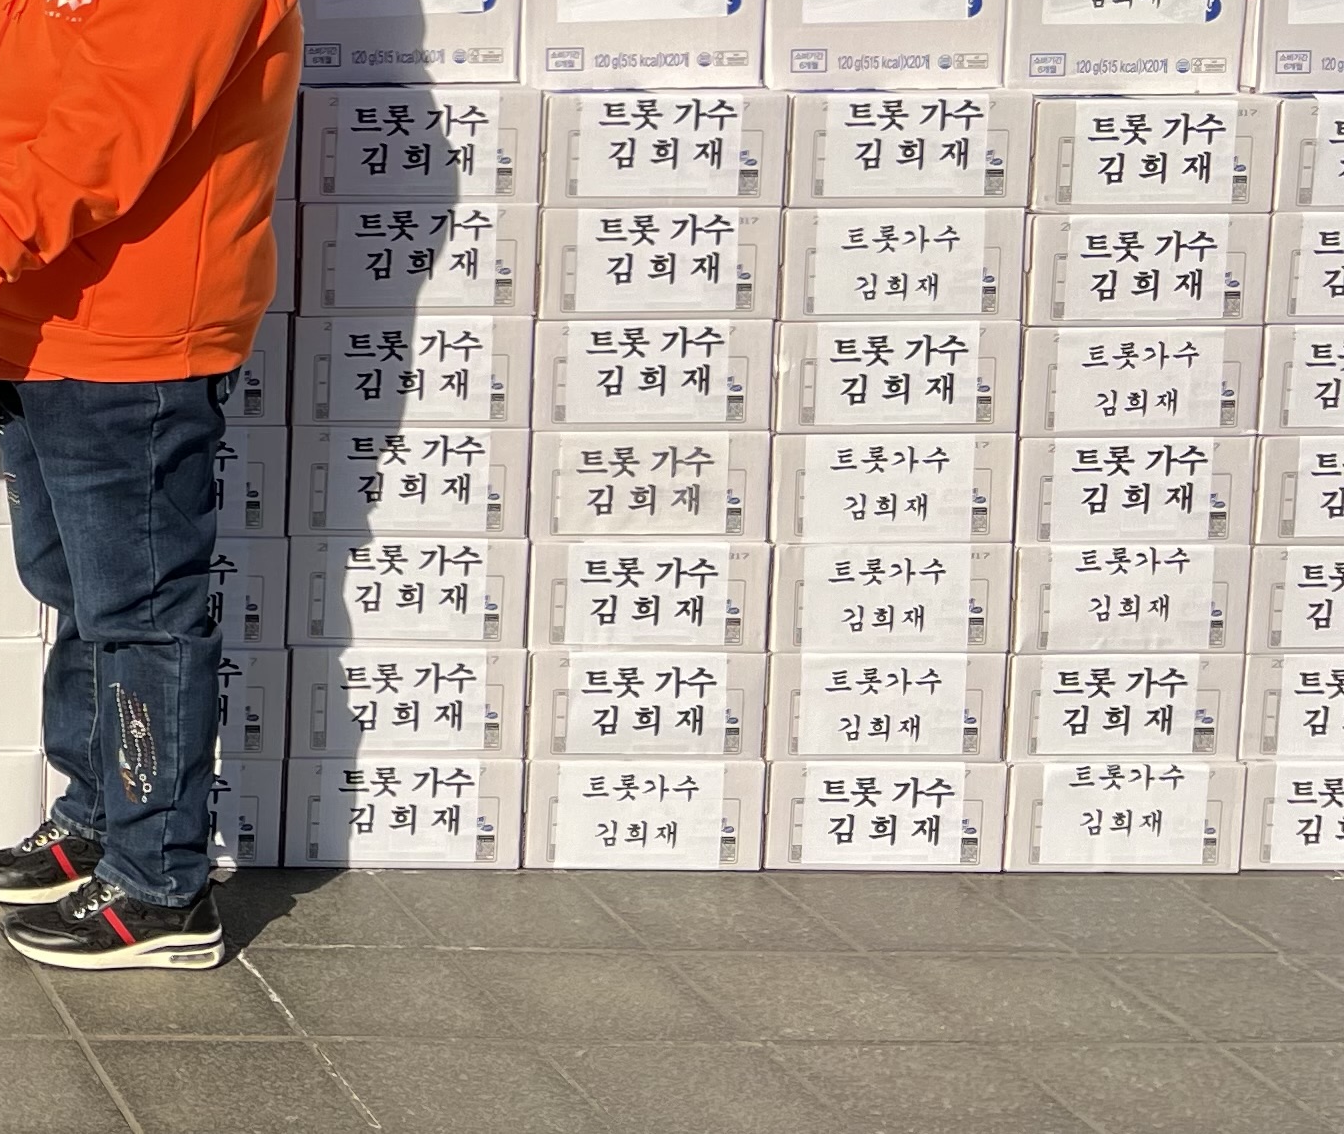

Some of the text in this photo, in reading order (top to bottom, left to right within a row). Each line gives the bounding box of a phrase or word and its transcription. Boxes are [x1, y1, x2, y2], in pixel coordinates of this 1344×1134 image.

[351, 50, 367, 63] 120
[594, 54, 610, 67] 120
[838, 56, 853, 69] 120
[1076, 60, 1091, 73] 120
[841, 224, 961, 254] 트롯가수
[855, 272, 939, 301] 김희재
[1081, 340, 1200, 371] 트롯가수
[1095, 387, 1178, 418] 김희재
[582, 773, 700, 802] 트롯가수
[596, 819, 678, 849] 김희재
